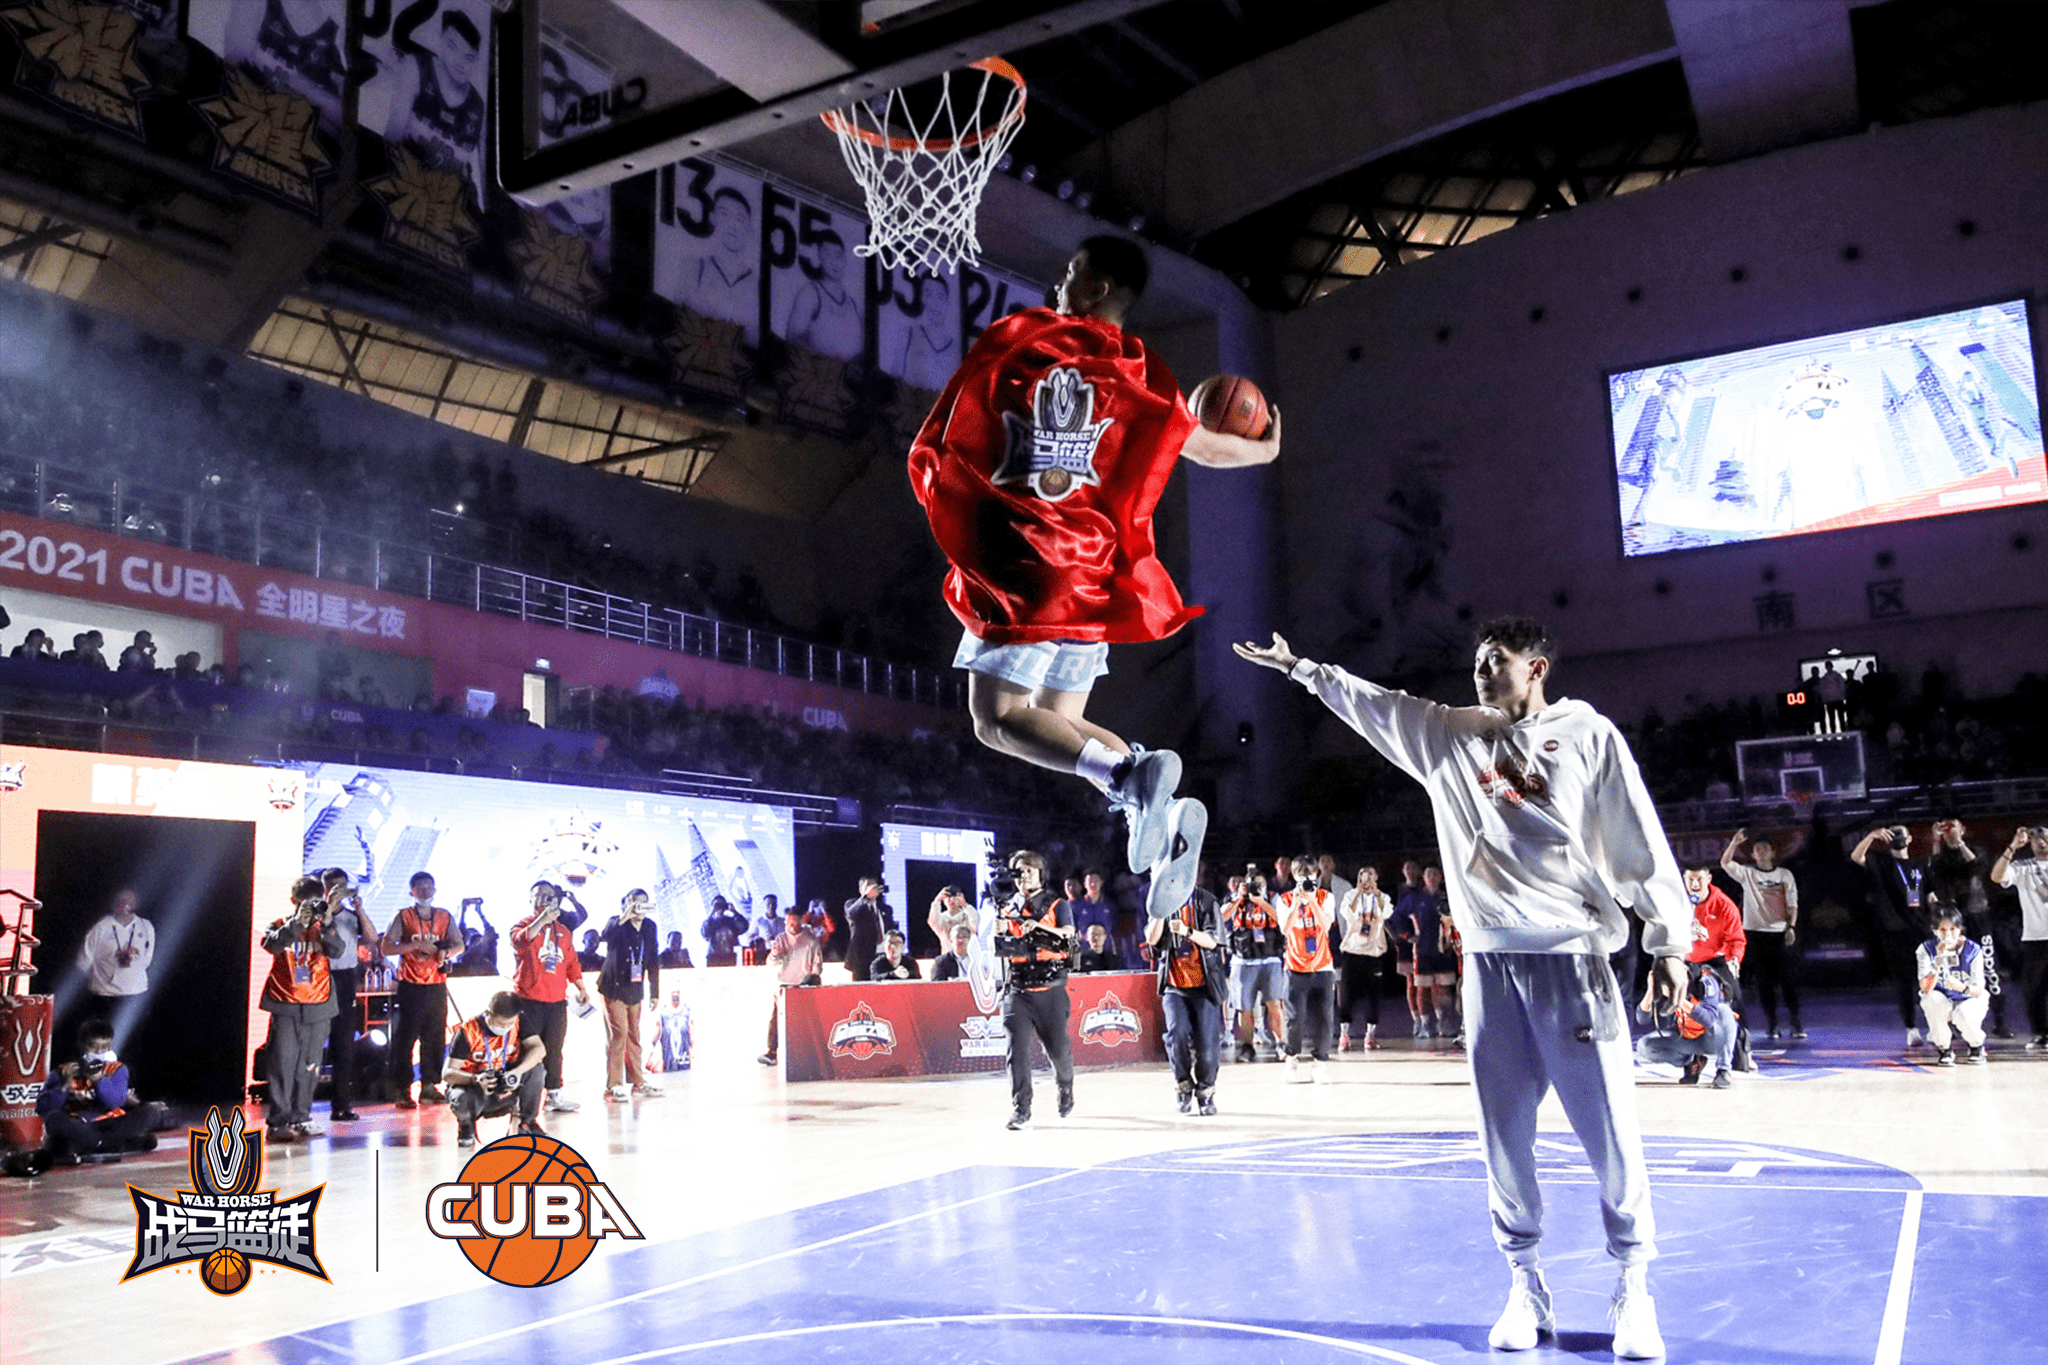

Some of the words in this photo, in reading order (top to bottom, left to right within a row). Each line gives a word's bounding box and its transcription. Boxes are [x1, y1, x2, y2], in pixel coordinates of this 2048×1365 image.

[659, 157, 716, 239] 13
[1055, 429, 1092, 441] HORSE
[0, 529, 107, 586] 2021
[121, 556, 244, 611] CUBA
[256, 582, 407, 639] 全明星之夜
